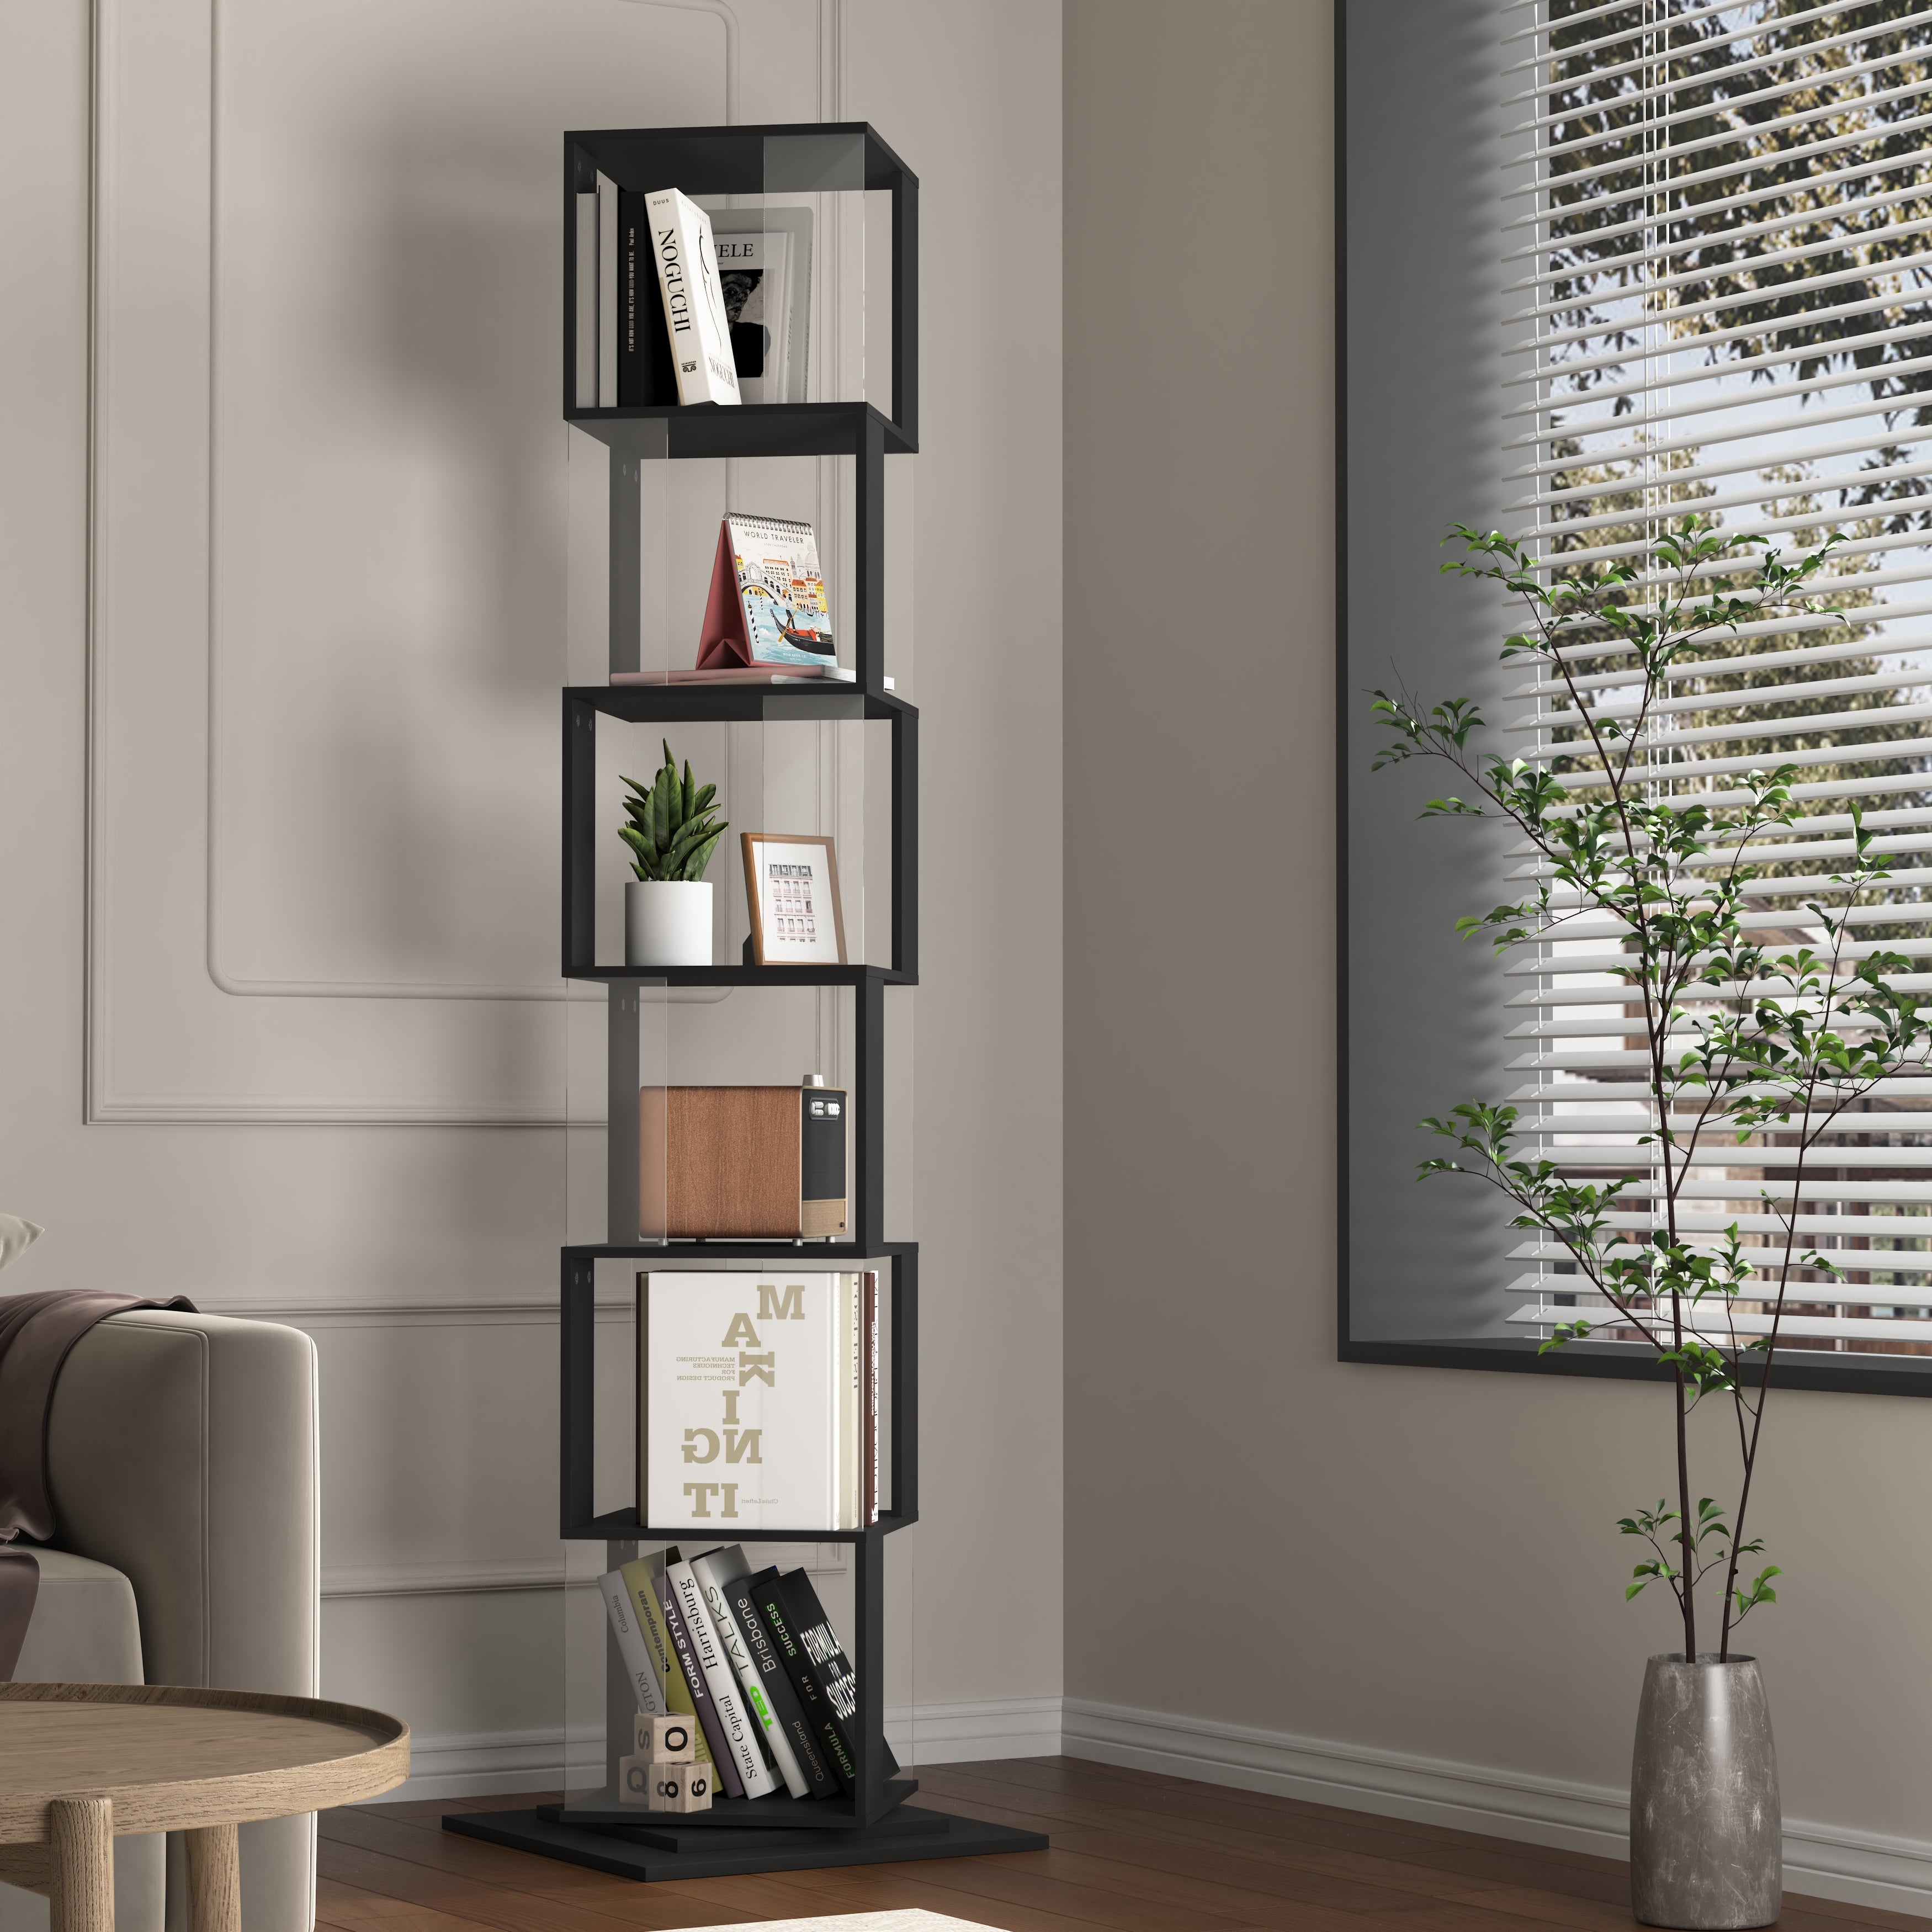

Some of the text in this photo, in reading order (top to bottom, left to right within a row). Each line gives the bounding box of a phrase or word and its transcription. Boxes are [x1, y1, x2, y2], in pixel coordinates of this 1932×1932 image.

[659, 228, 691, 333] NOGUCHI
[744, 530, 804, 544] WORLD TRAVELER
[613, 1595, 629, 1633] Columbia
[664, 1600, 704, 1699] FORM STYLE
[680, 1578, 718, 1670] Harrisburg
[737, 1598, 777, 1673] Brisbane
[800, 1620, 843, 1666] FORMULA
[705, 1586, 773, 1732] TED TALKS
[767, 1603, 855, 1779] FORMULA FOR SUCCESS
[828, 1660, 842, 1679] FOR
[719, 1695, 757, 1779] State Capital
[792, 1721, 824, 1781] Queensland
